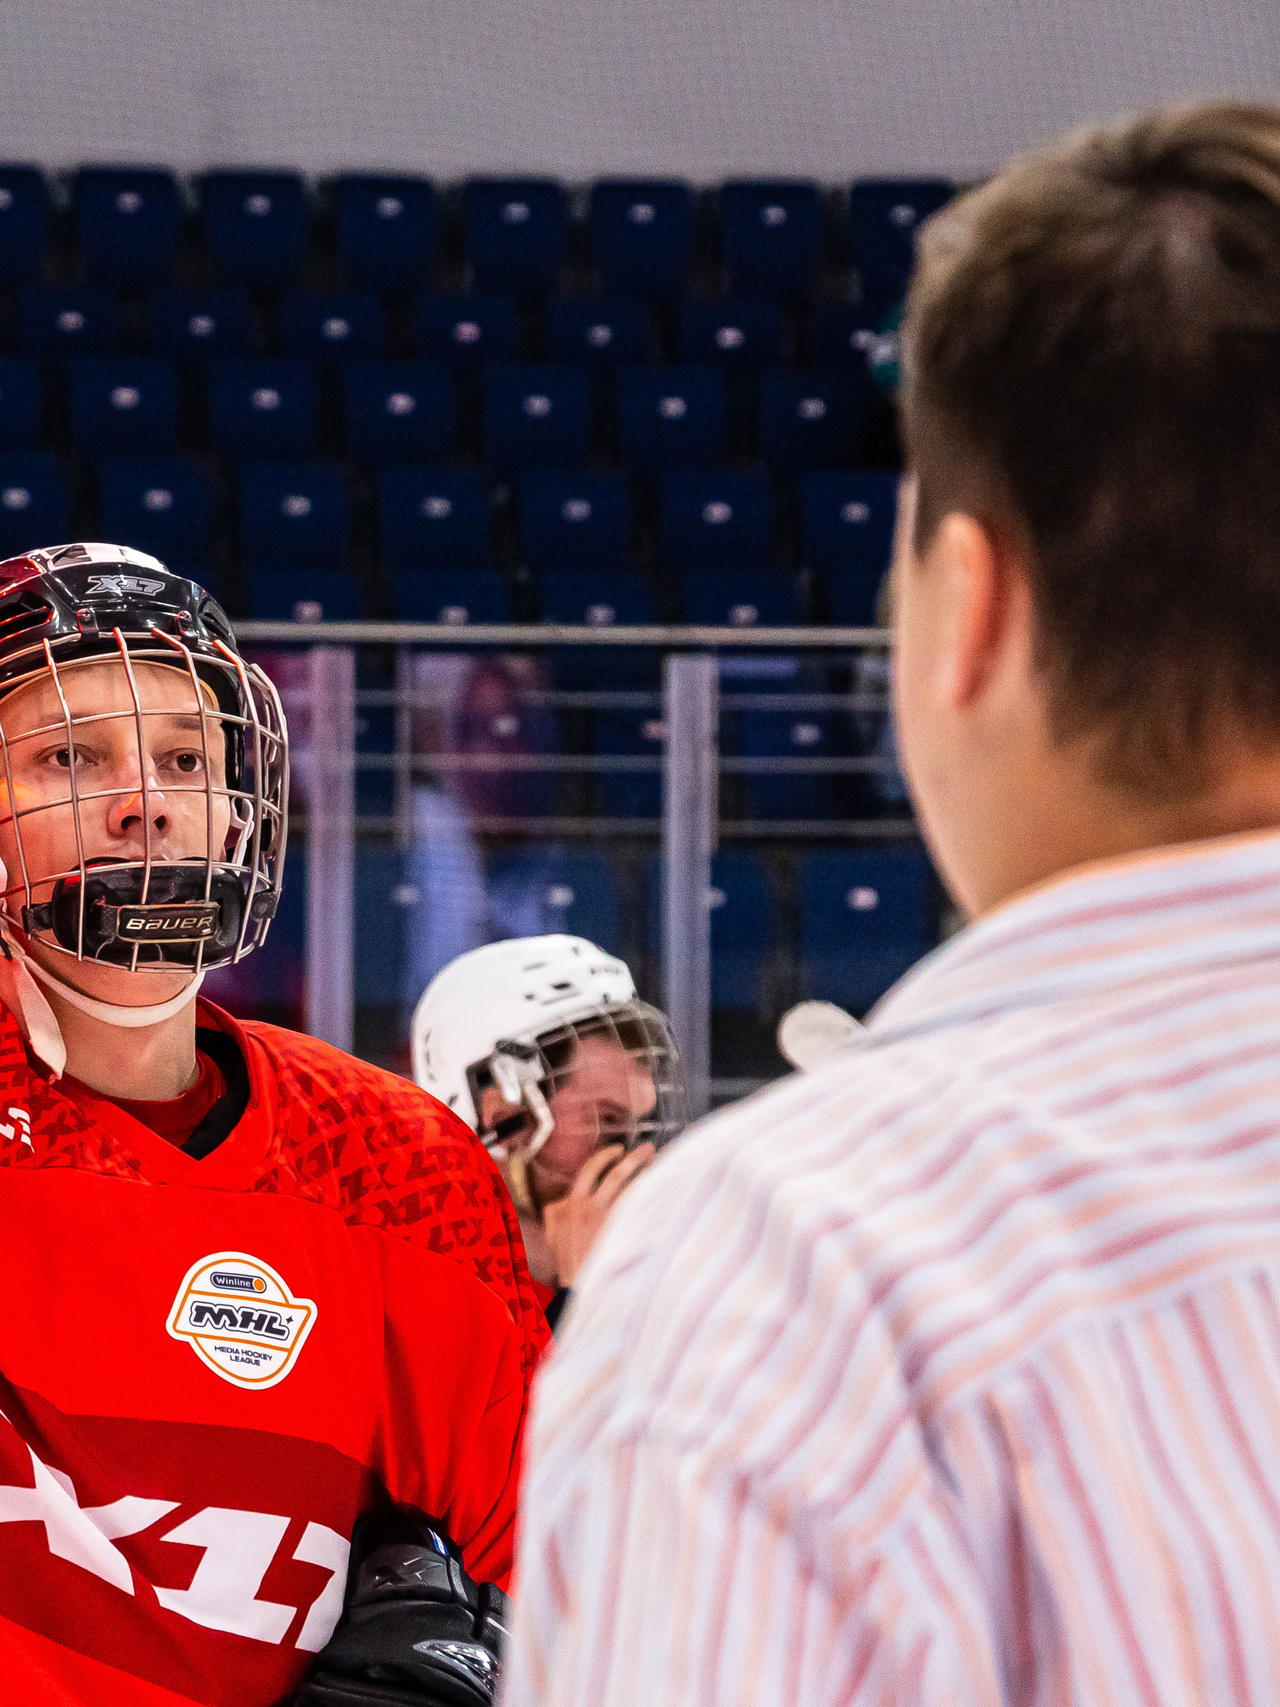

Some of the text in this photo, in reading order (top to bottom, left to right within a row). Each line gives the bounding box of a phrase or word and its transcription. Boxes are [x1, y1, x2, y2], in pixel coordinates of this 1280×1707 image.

[85, 575, 165, 596] X17
[125, 915, 213, 931] BAUER
[216, 1276, 251, 1287] Winline
[192, 1305, 286, 1337] MHL
[214, 1346, 273, 1361] MEDIA HOCKEY
[230, 1355, 260, 1366] LEAGUE
